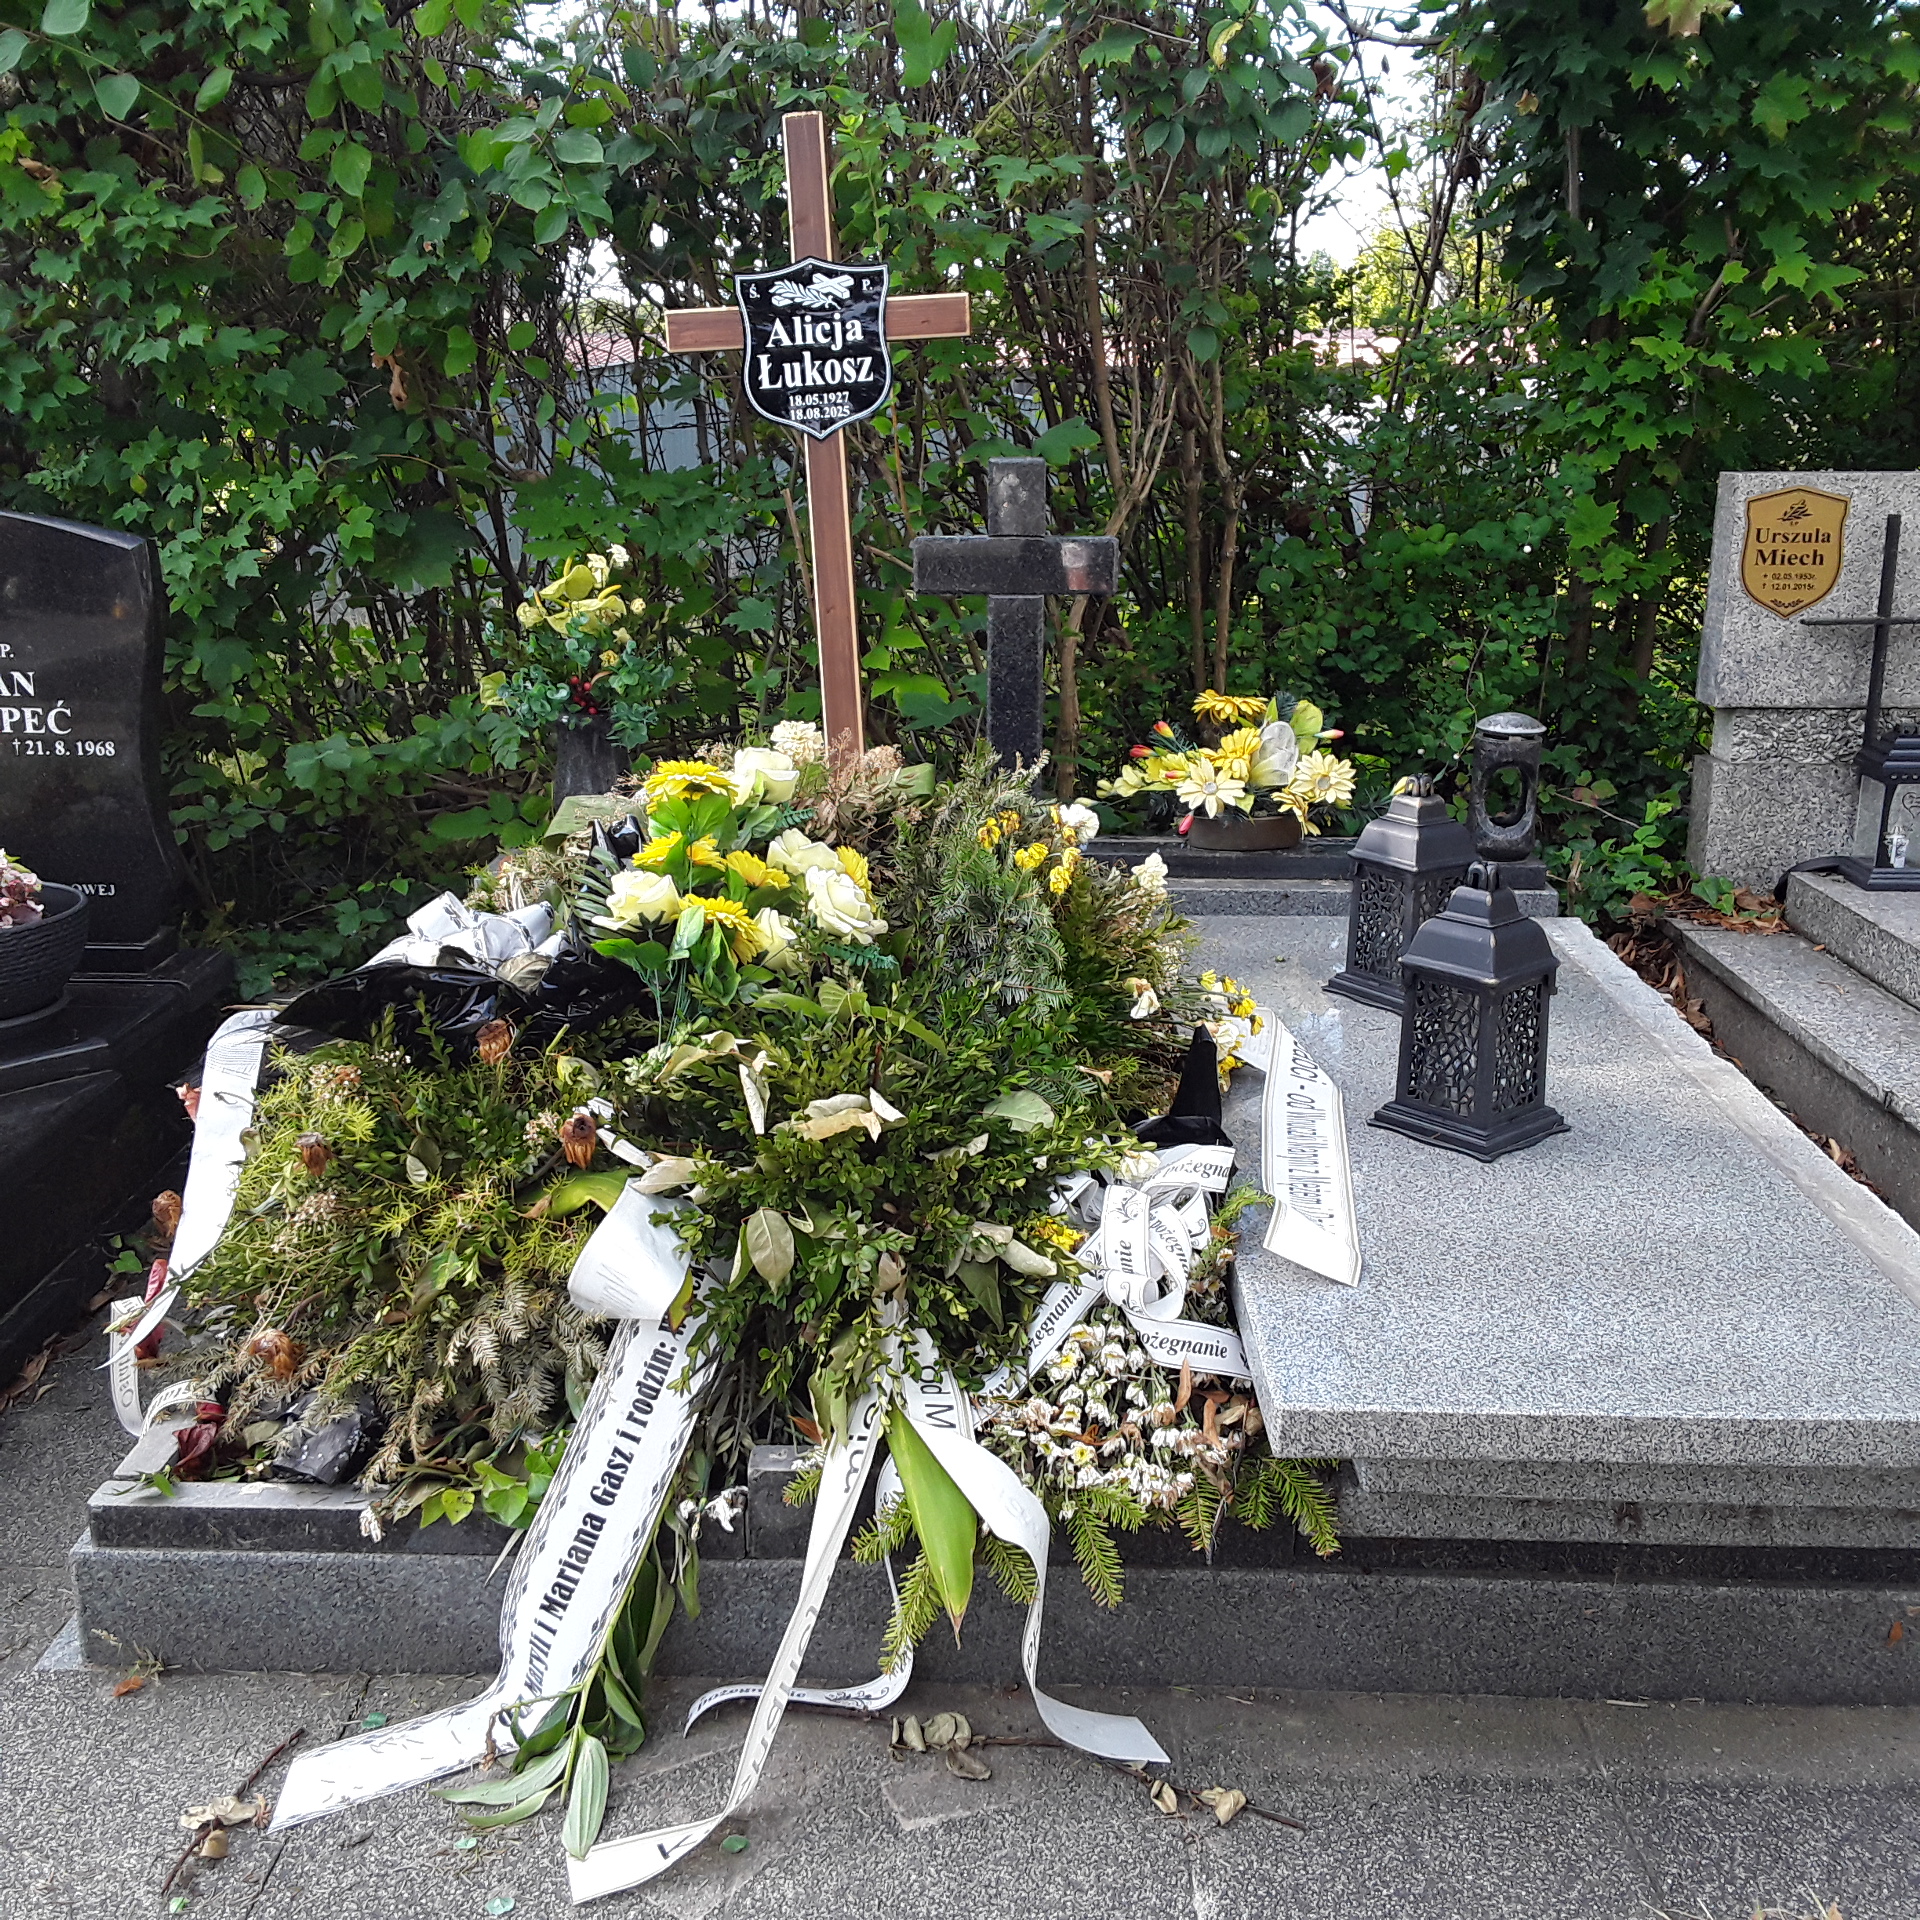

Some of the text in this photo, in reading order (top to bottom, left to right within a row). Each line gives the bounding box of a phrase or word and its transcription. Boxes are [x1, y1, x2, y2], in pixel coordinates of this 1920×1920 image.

[861, 278, 873, 291] P.
[765, 312, 864, 351] Alicja
[756, 351, 874, 390] Łukosz
[789, 391, 849, 407] 18.05.1927
[790, 405, 850, 421] 18.08.2025
[1755, 527, 1832, 544] Urszula
[1754, 548, 1825, 566] Miech
[25, 740, 116, 757] 21. 8. 1968
[1137, 1331, 1229, 1359] ożegnanie
[626, 1341, 678, 1427] rodzin:
[616, 1428, 641, 1445] i
[591, 1446, 634, 1508] Gasz
[539, 1511, 607, 1621] Mariana
[524, 1631, 552, 1698] Maryli
